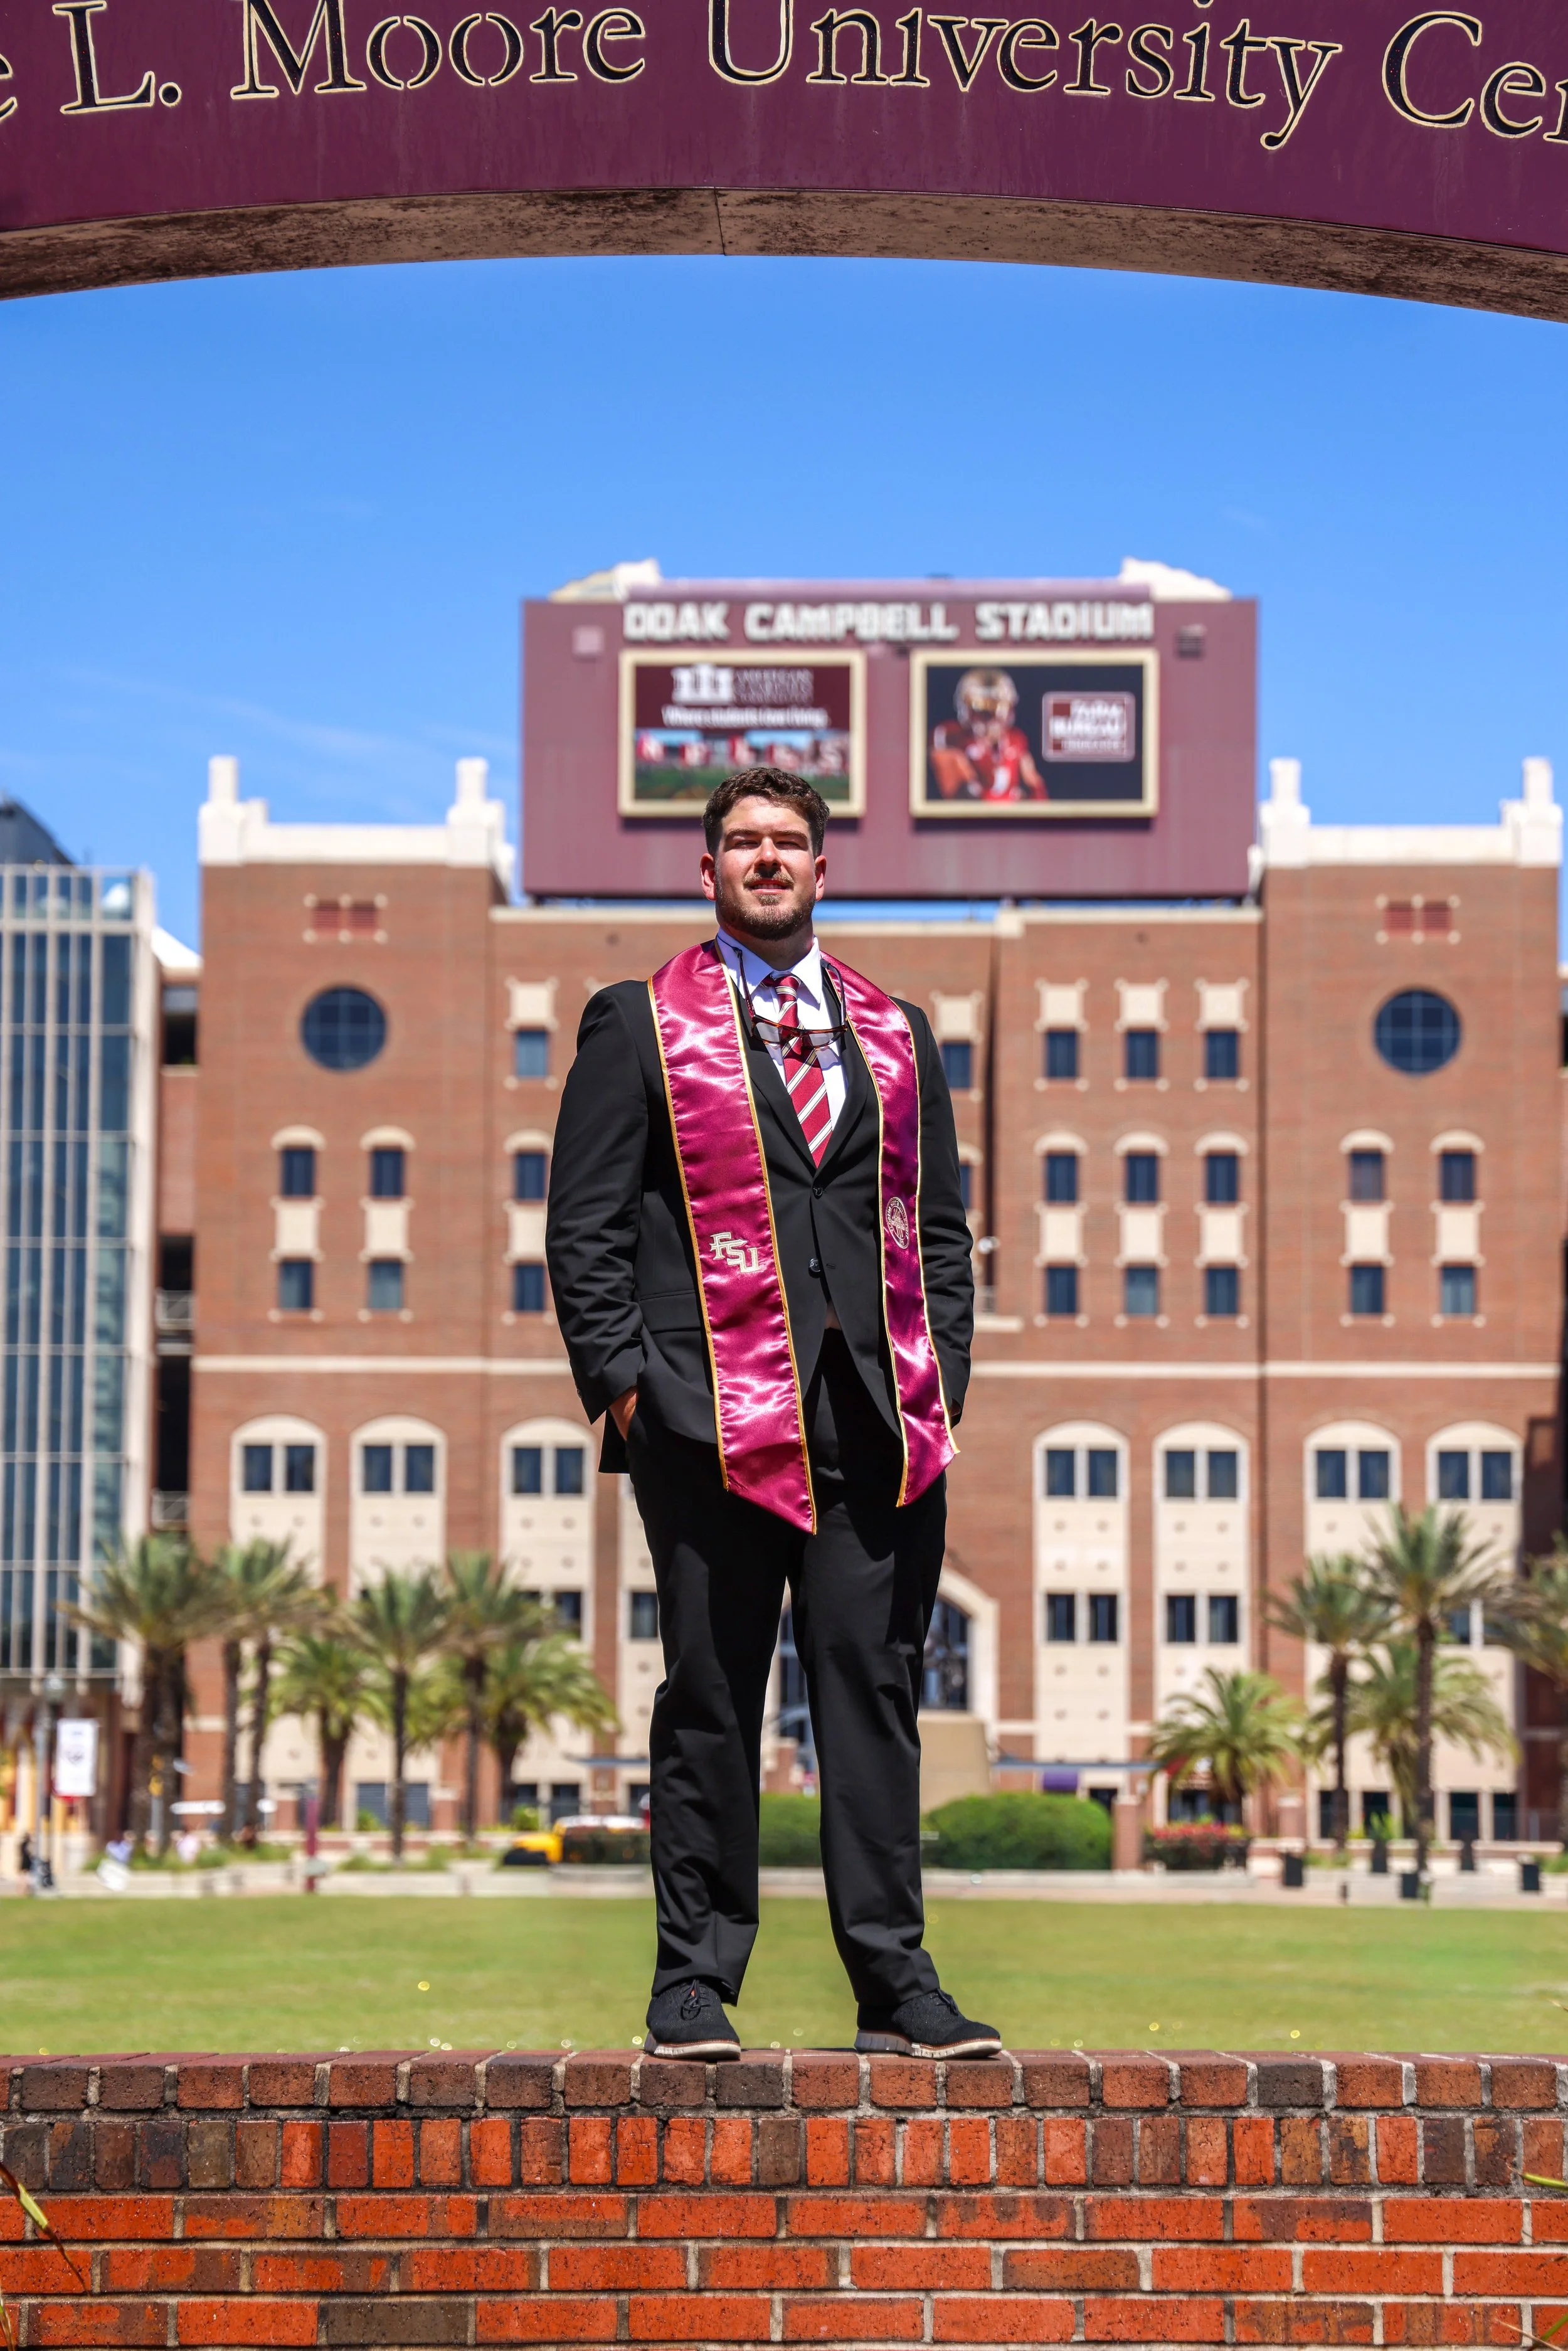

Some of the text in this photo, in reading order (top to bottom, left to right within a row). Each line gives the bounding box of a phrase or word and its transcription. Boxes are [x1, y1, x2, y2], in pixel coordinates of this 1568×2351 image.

[52, 0, 181, 114] L.
[230, 0, 645, 98] Moore
[709, 0, 1342, 150] University
[623, 602, 1155, 643] DOAK CAMPBELL STADIUM
[709, 1232, 761, 1273] FSU
